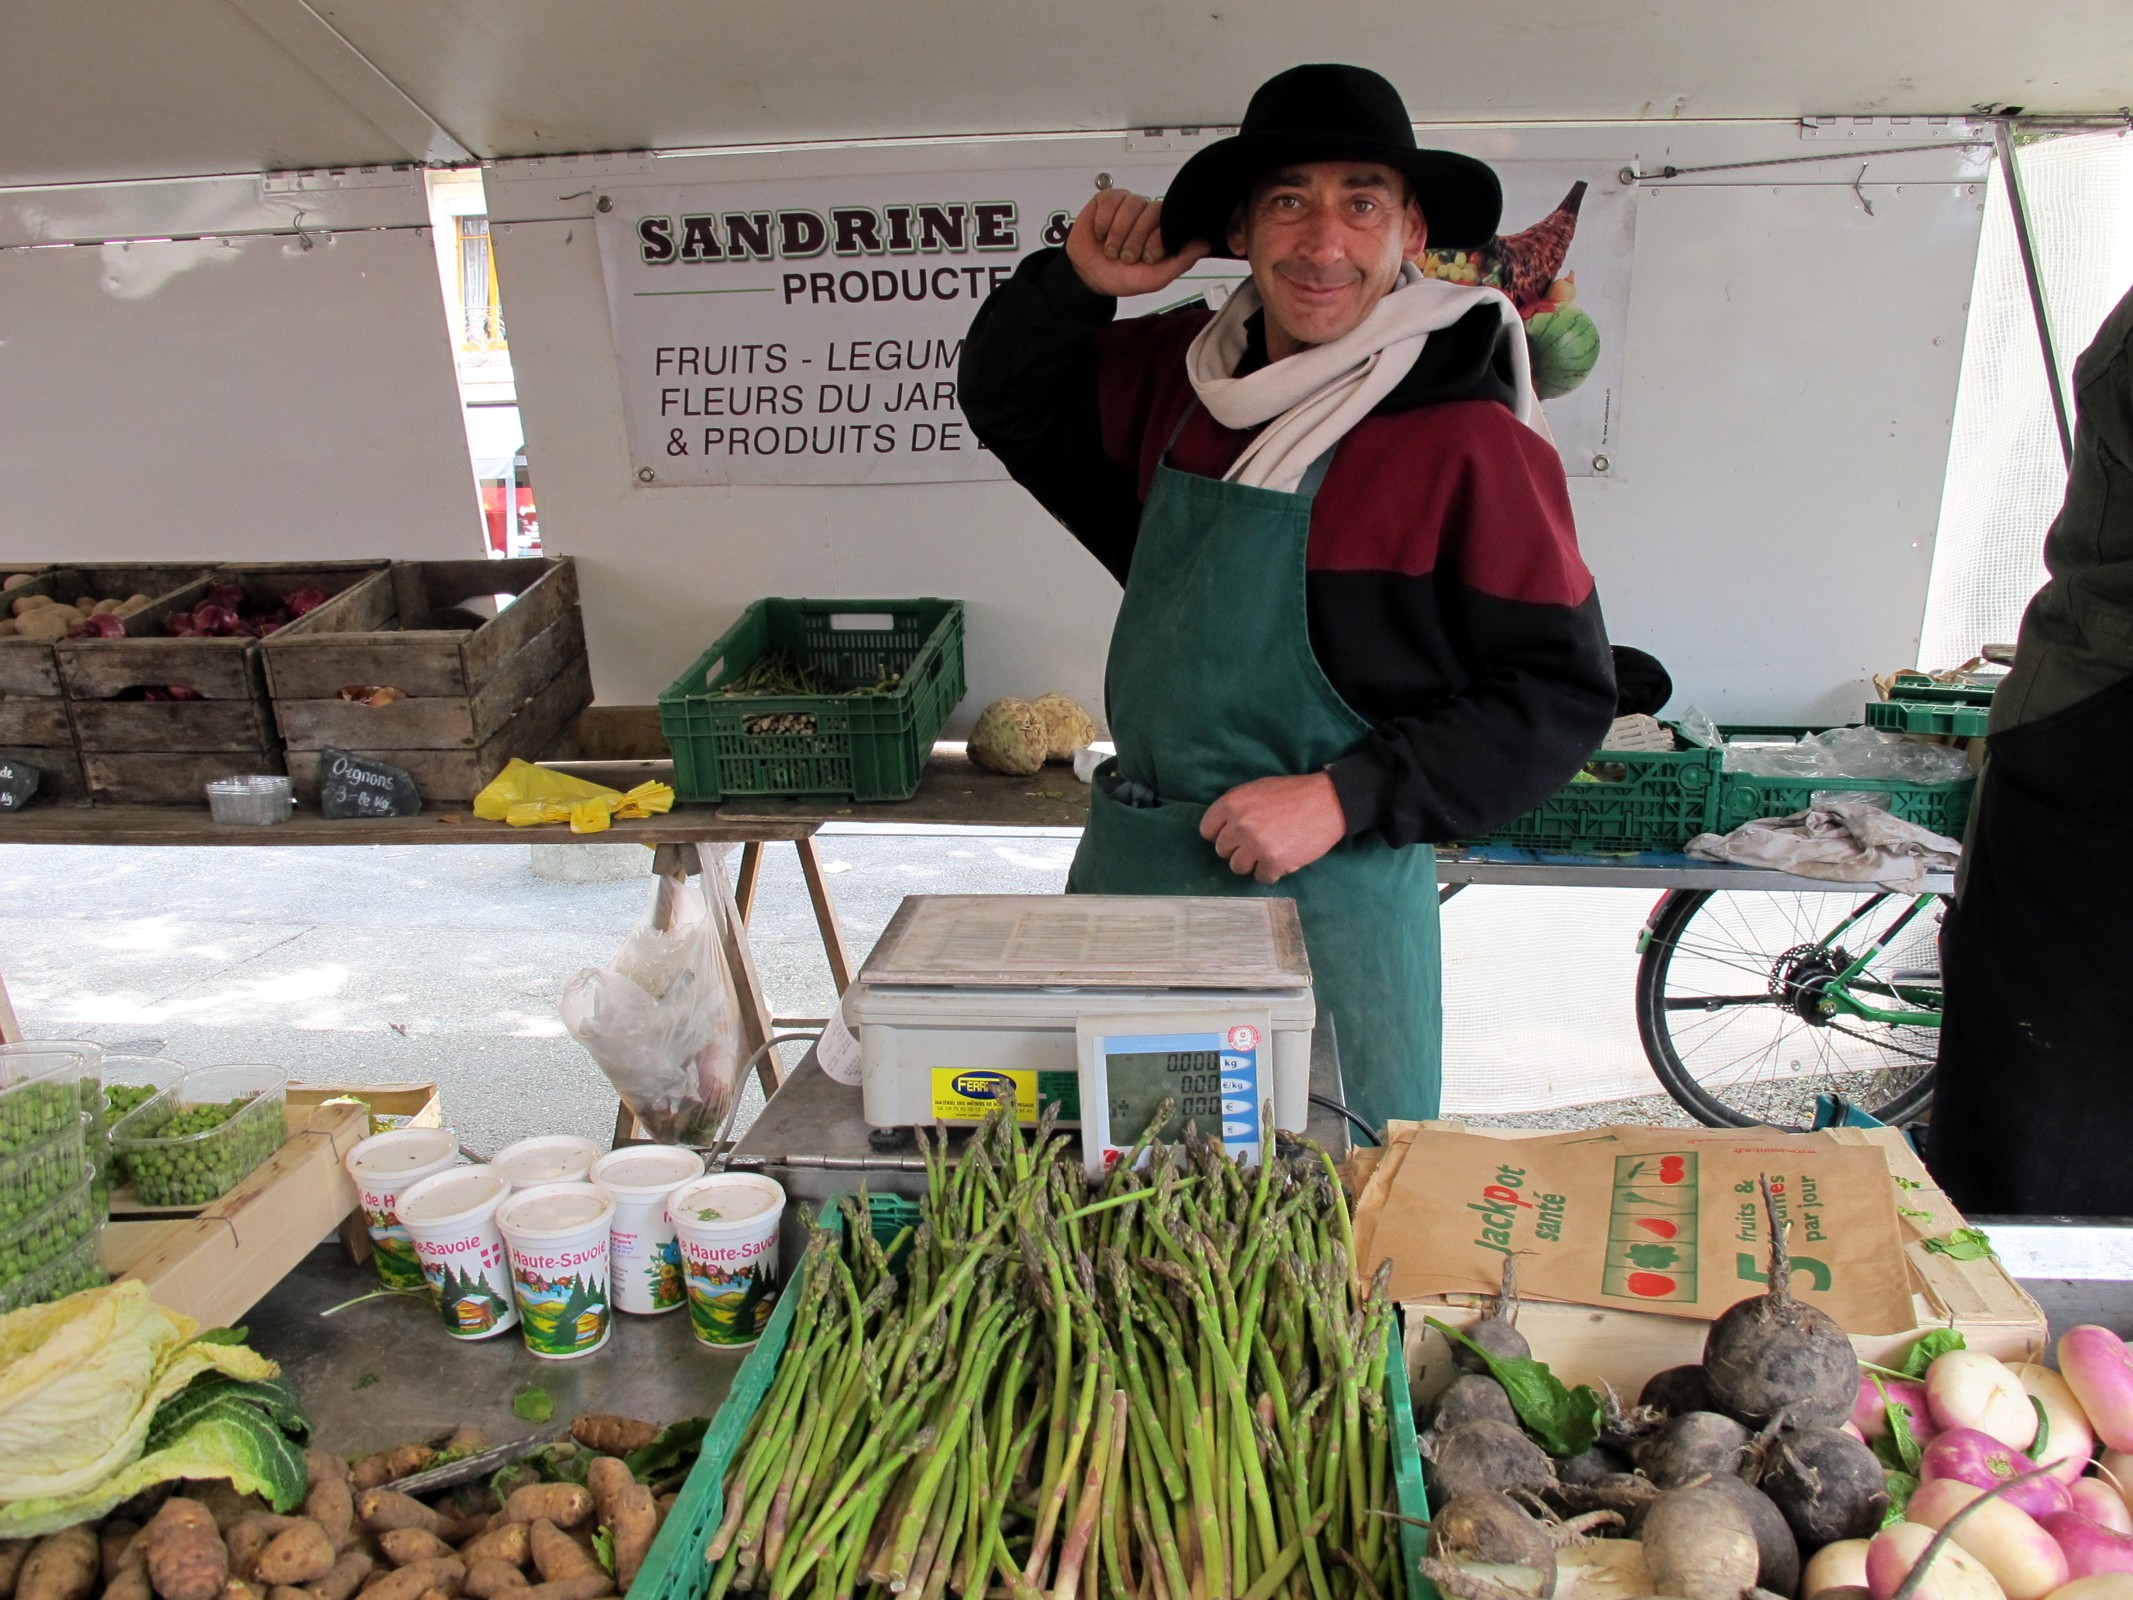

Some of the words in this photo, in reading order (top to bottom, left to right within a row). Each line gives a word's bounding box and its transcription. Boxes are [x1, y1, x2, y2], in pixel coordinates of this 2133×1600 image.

[638, 202, 1017, 262] SANDRINE
[656, 343, 787, 375] FRUITS
[828, 339, 965, 371] LEGUM
[661, 384, 803, 416] FLEURS
[818, 384, 870, 413] DU
[884, 381, 957, 412] JAR
[666, 427, 689, 456] &
[704, 424, 896, 455] PRODUITS
[911, 423, 963, 451] DE
[332, 757, 395, 791] Oignons
[1224, 1059, 1237, 1068] kg
[1222, 1081, 1243, 1090] €/kg
[1225, 1102, 1234, 1111] €
[1227, 1125, 1234, 1133] €
[1734, 1179, 1755, 1194] &
[1797, 1175, 1824, 1209] jour
[1466, 1164, 1526, 1257] Jackpot
[1533, 1190, 1566, 1242] santé
[1736, 1203, 1757, 1242] fruits
[1805, 1213, 1827, 1242] par
[512, 1240, 607, 1269] Haute-Savoie
